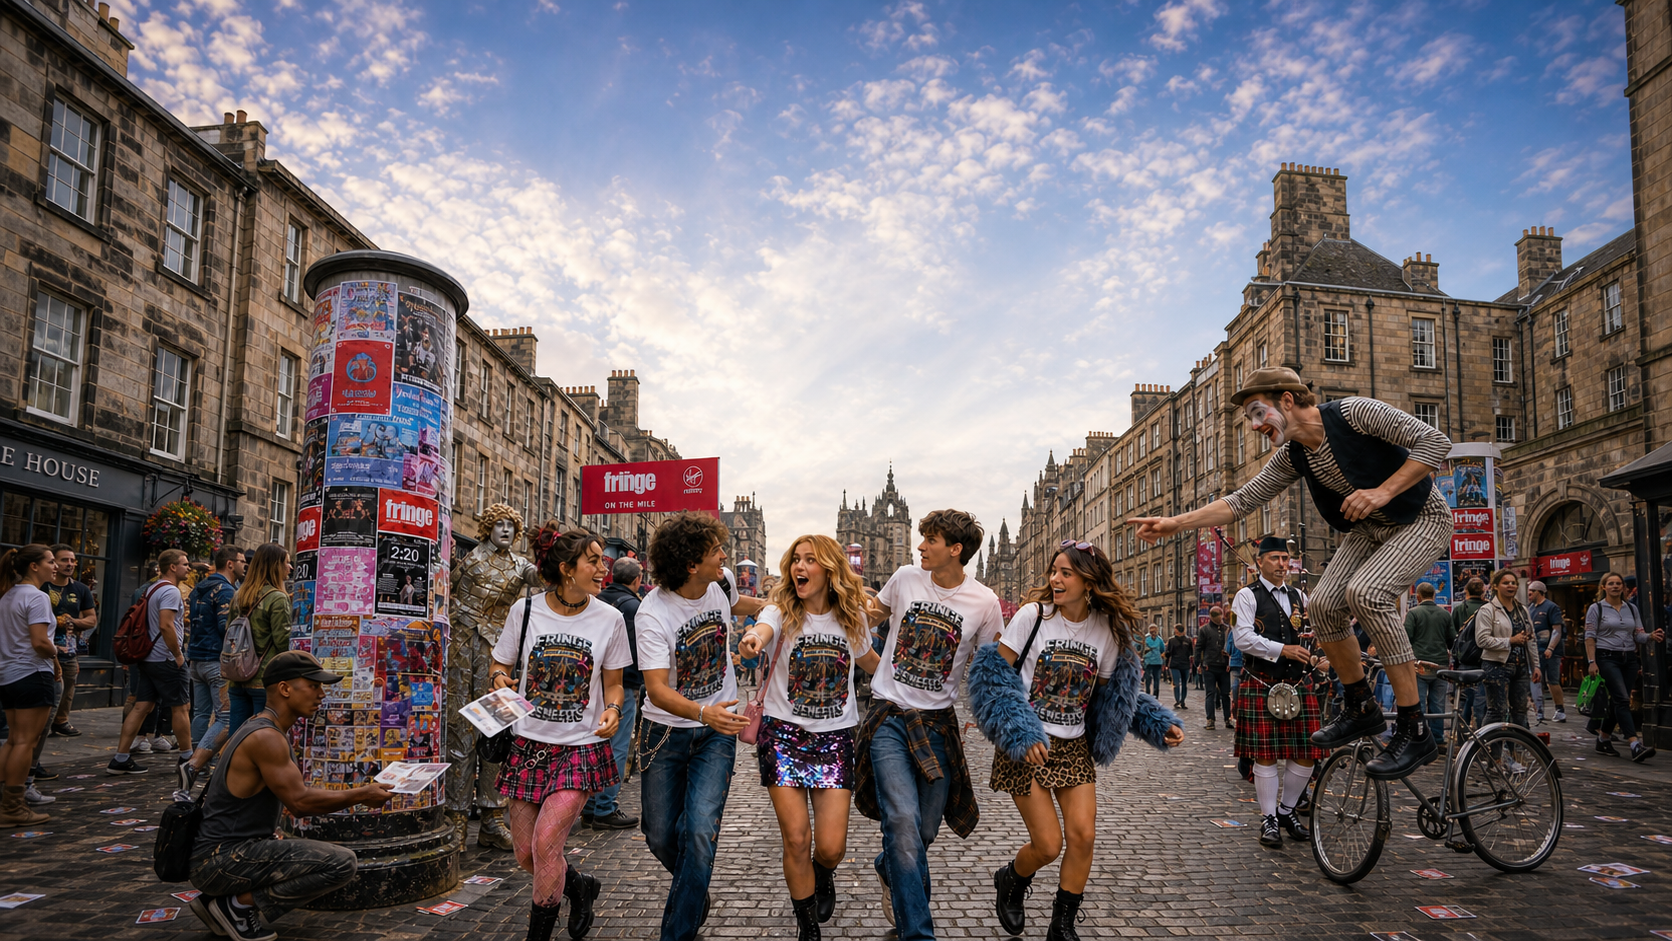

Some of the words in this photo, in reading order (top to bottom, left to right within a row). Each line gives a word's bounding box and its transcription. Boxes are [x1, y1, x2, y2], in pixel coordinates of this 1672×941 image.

[24, 452, 100, 487] HOUSE
[604, 471, 656, 494] fringe
[385, 499, 433, 528] fringe
[619, 501, 634, 509] THE
[637, 500, 655, 508] MILE
[390, 546, 419, 562] 2:20
